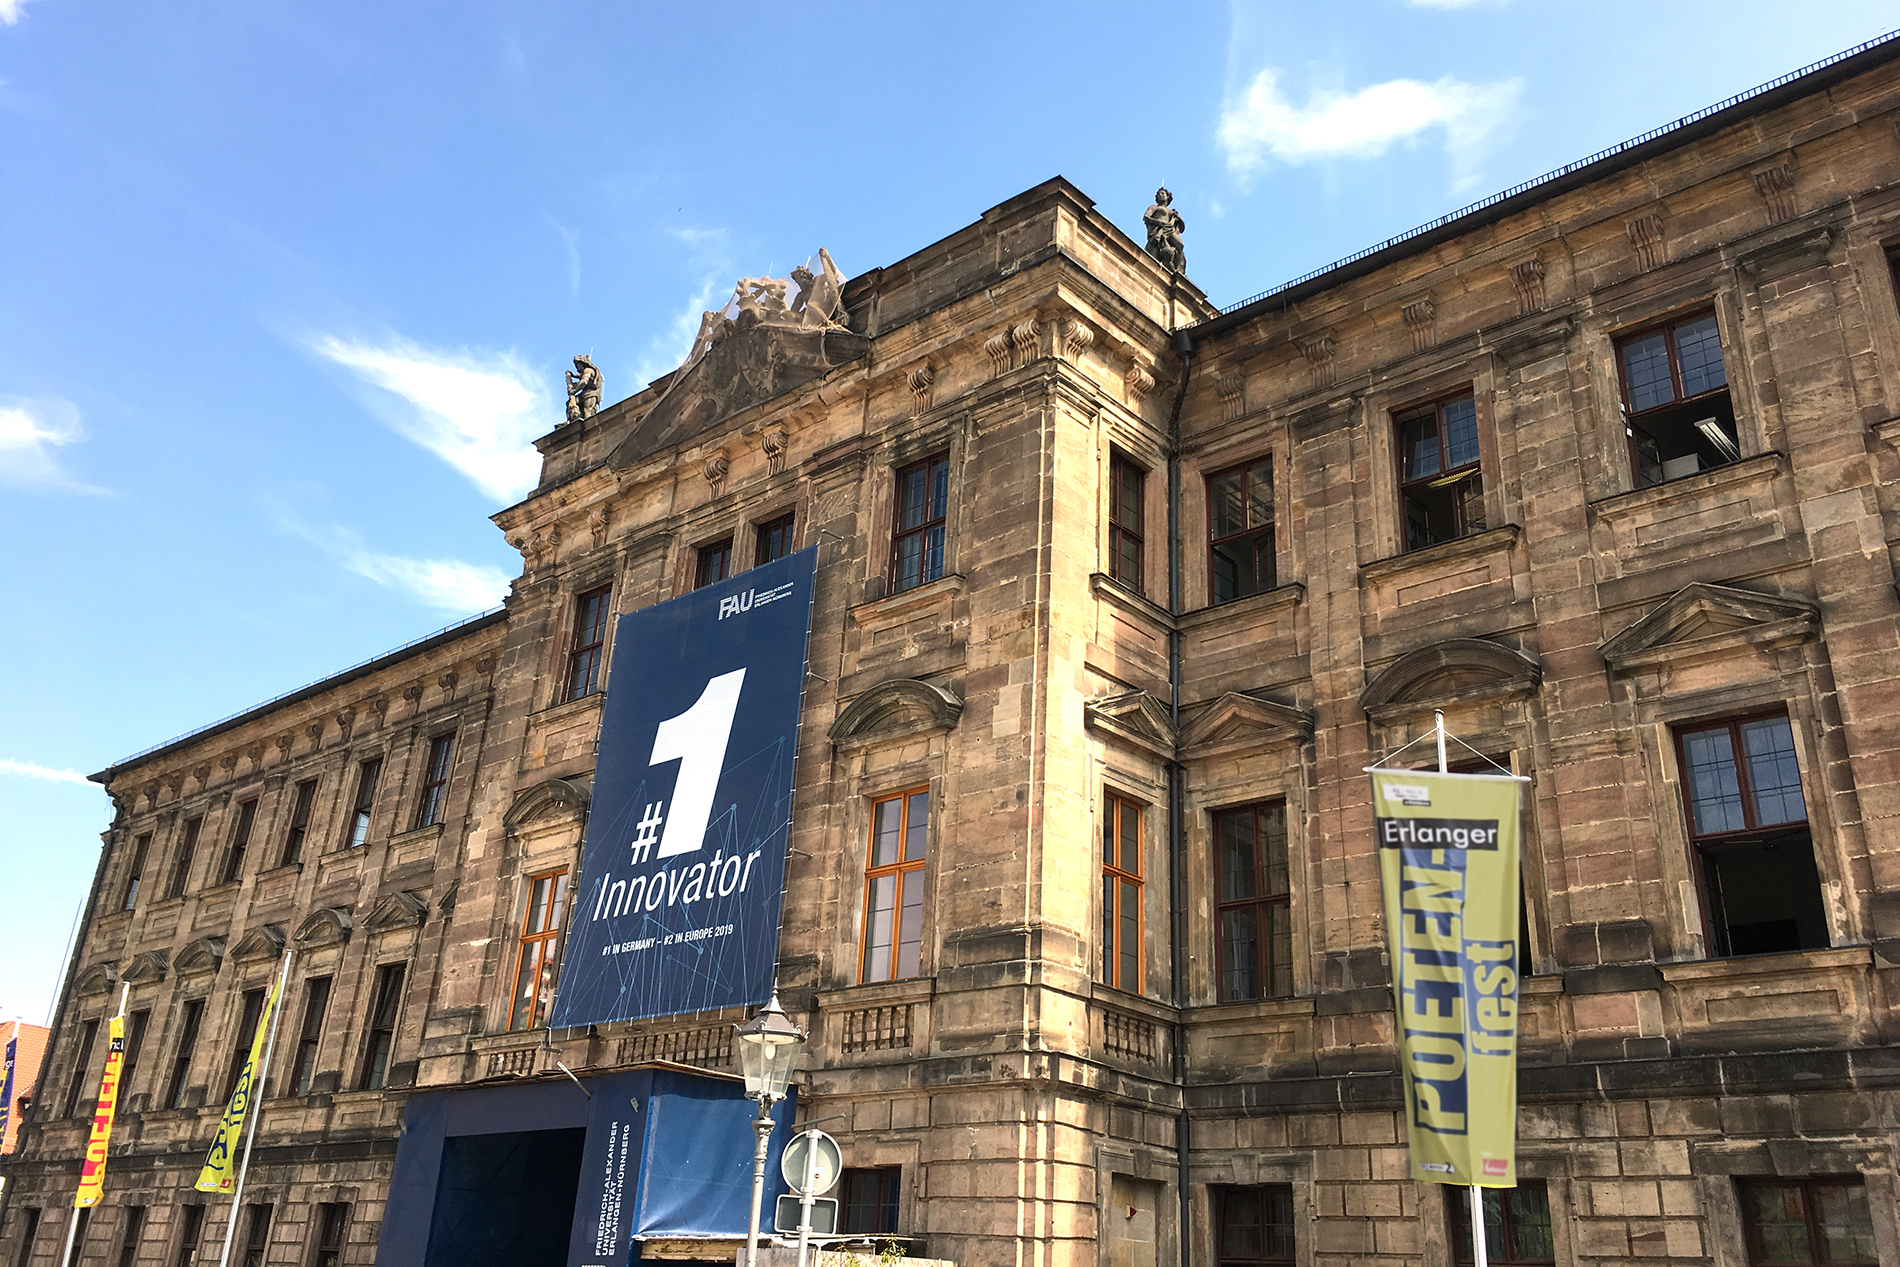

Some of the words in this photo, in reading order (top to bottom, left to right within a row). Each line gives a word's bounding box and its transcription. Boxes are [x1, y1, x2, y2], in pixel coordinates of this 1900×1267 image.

[718, 588, 755, 620] FAU
[1384, 820, 1497, 849] Erlanger
[593, 849, 761, 921] Innovator
[602, 945, 611, 956] #1
[612, 943, 620, 955] IN
[621, 937, 656, 953] GERMANY
[663, 935, 673, 946] #2
[674, 932, 684, 944] IN
[684, 927, 714, 942] EUROPE
[715, 924, 734, 936] 2019
[1466, 941, 1517, 1055] fest
[595, 1121, 618, 1256] FRIEDRICH-ALEXANDER
[602, 1181, 616, 1256] UNIVERSITÄT
[608, 1124, 630, 1256] ERLANGEN-NÜRNBERG
